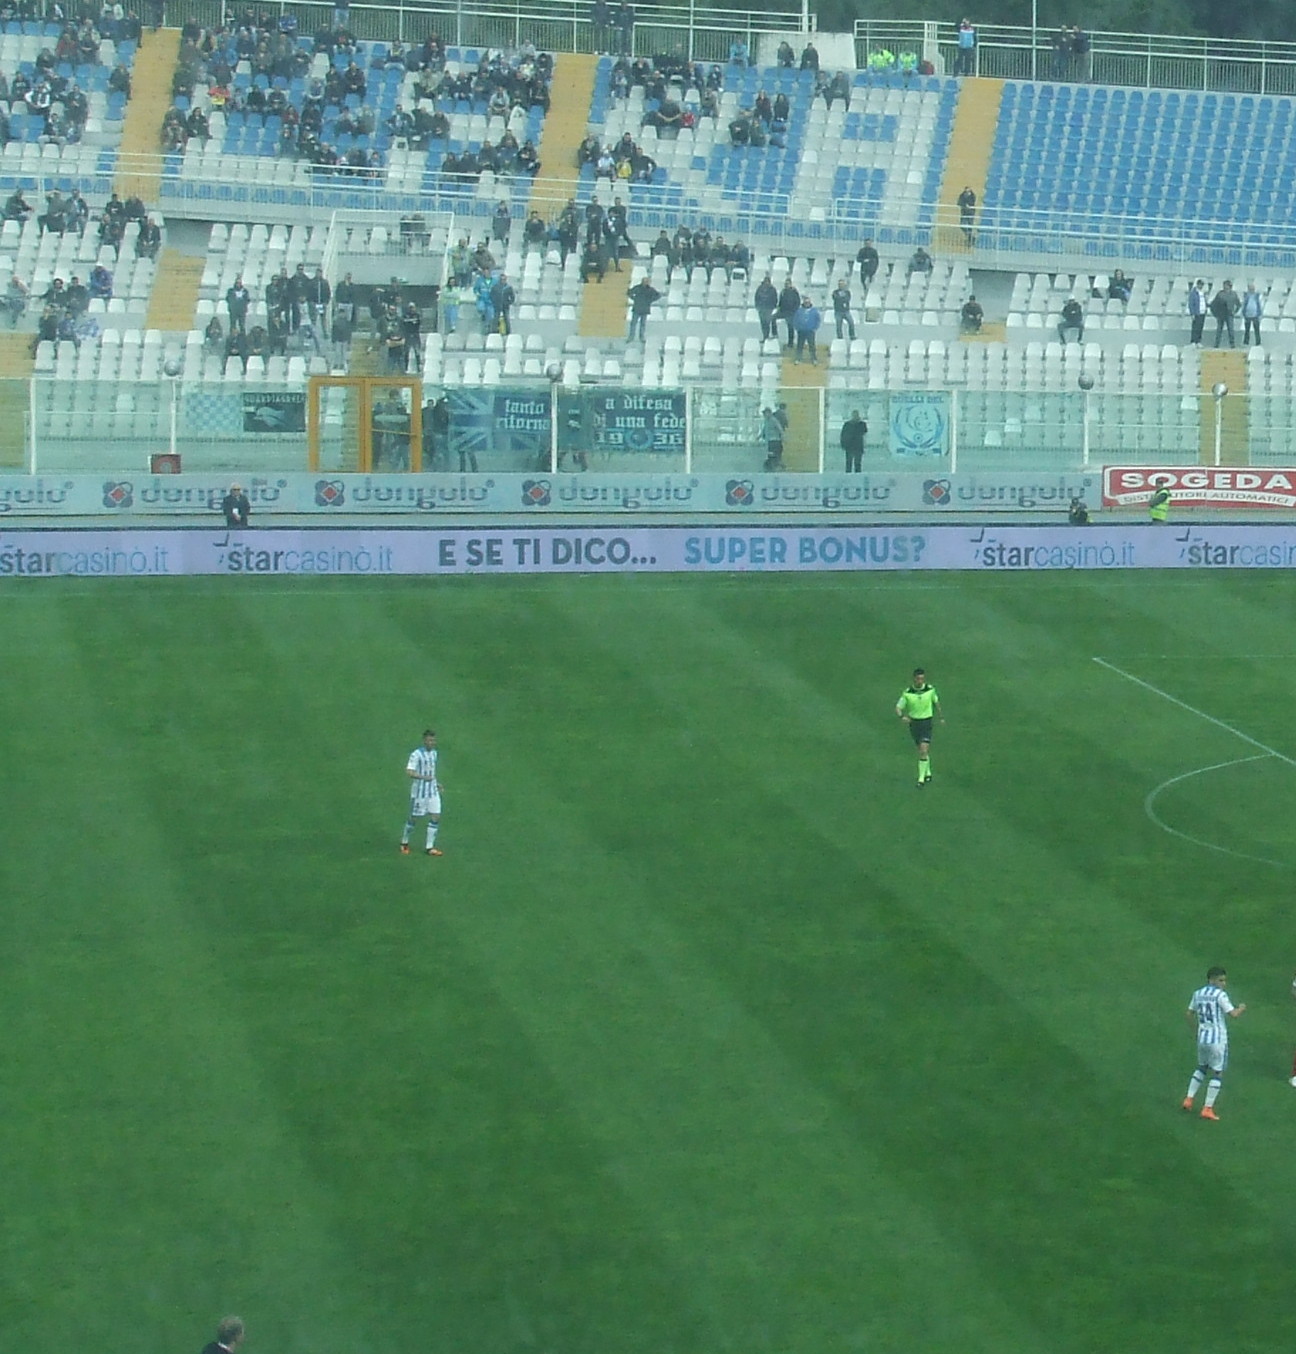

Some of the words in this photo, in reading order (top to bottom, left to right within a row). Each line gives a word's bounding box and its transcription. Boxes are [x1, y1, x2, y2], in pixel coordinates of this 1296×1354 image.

[1121, 473, 1293, 490] SOGEDA
[1123, 491, 1206, 502] DISTUTORI
[439, 539, 457, 567] E
[466, 539, 503, 566] SE
[512, 538, 541, 566] TI
[552, 537, 657, 566] DICO...
[684, 537, 788, 565] SUPER
[799, 535, 926, 565] BONUS?
